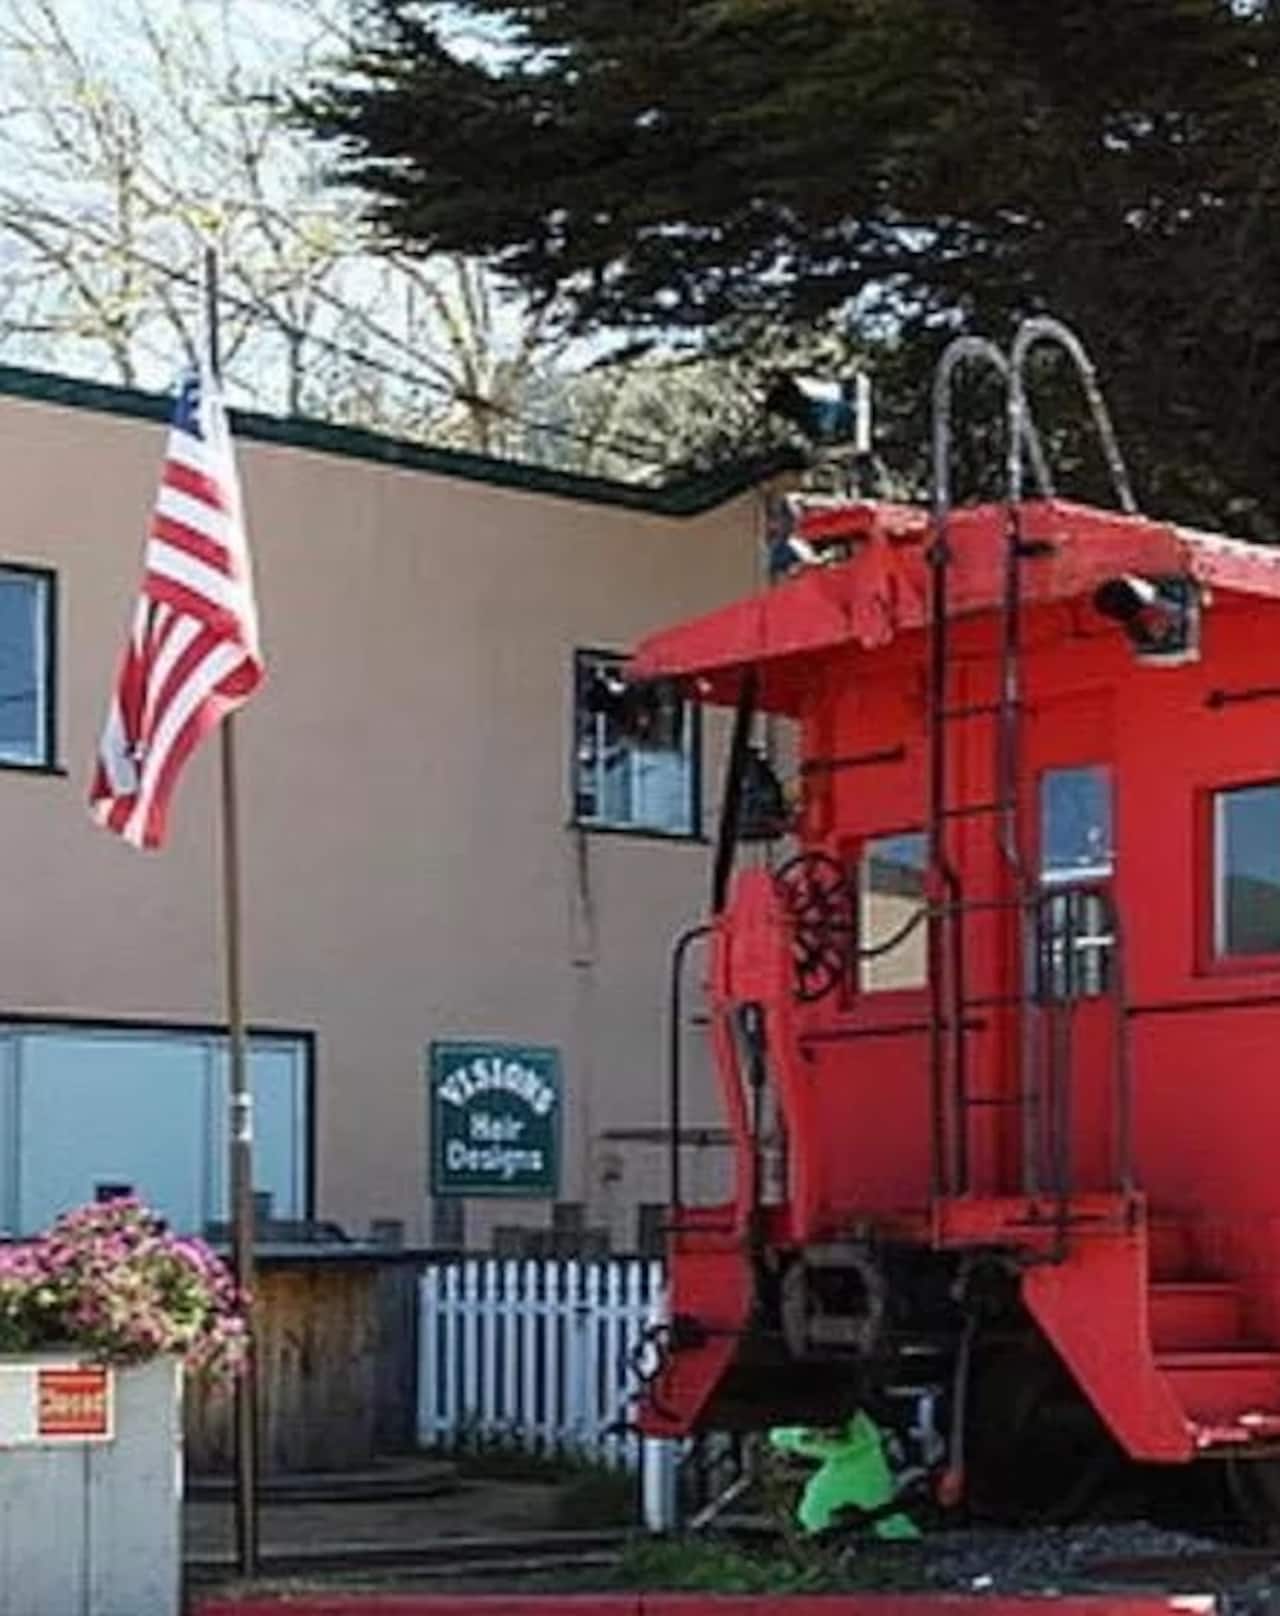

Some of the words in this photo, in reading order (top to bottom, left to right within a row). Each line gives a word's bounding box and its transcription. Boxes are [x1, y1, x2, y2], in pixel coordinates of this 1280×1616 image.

[438, 1058, 553, 1113] VISIONS
[471, 1114, 524, 1140] Hair
[447, 1140, 542, 1179] Designs
